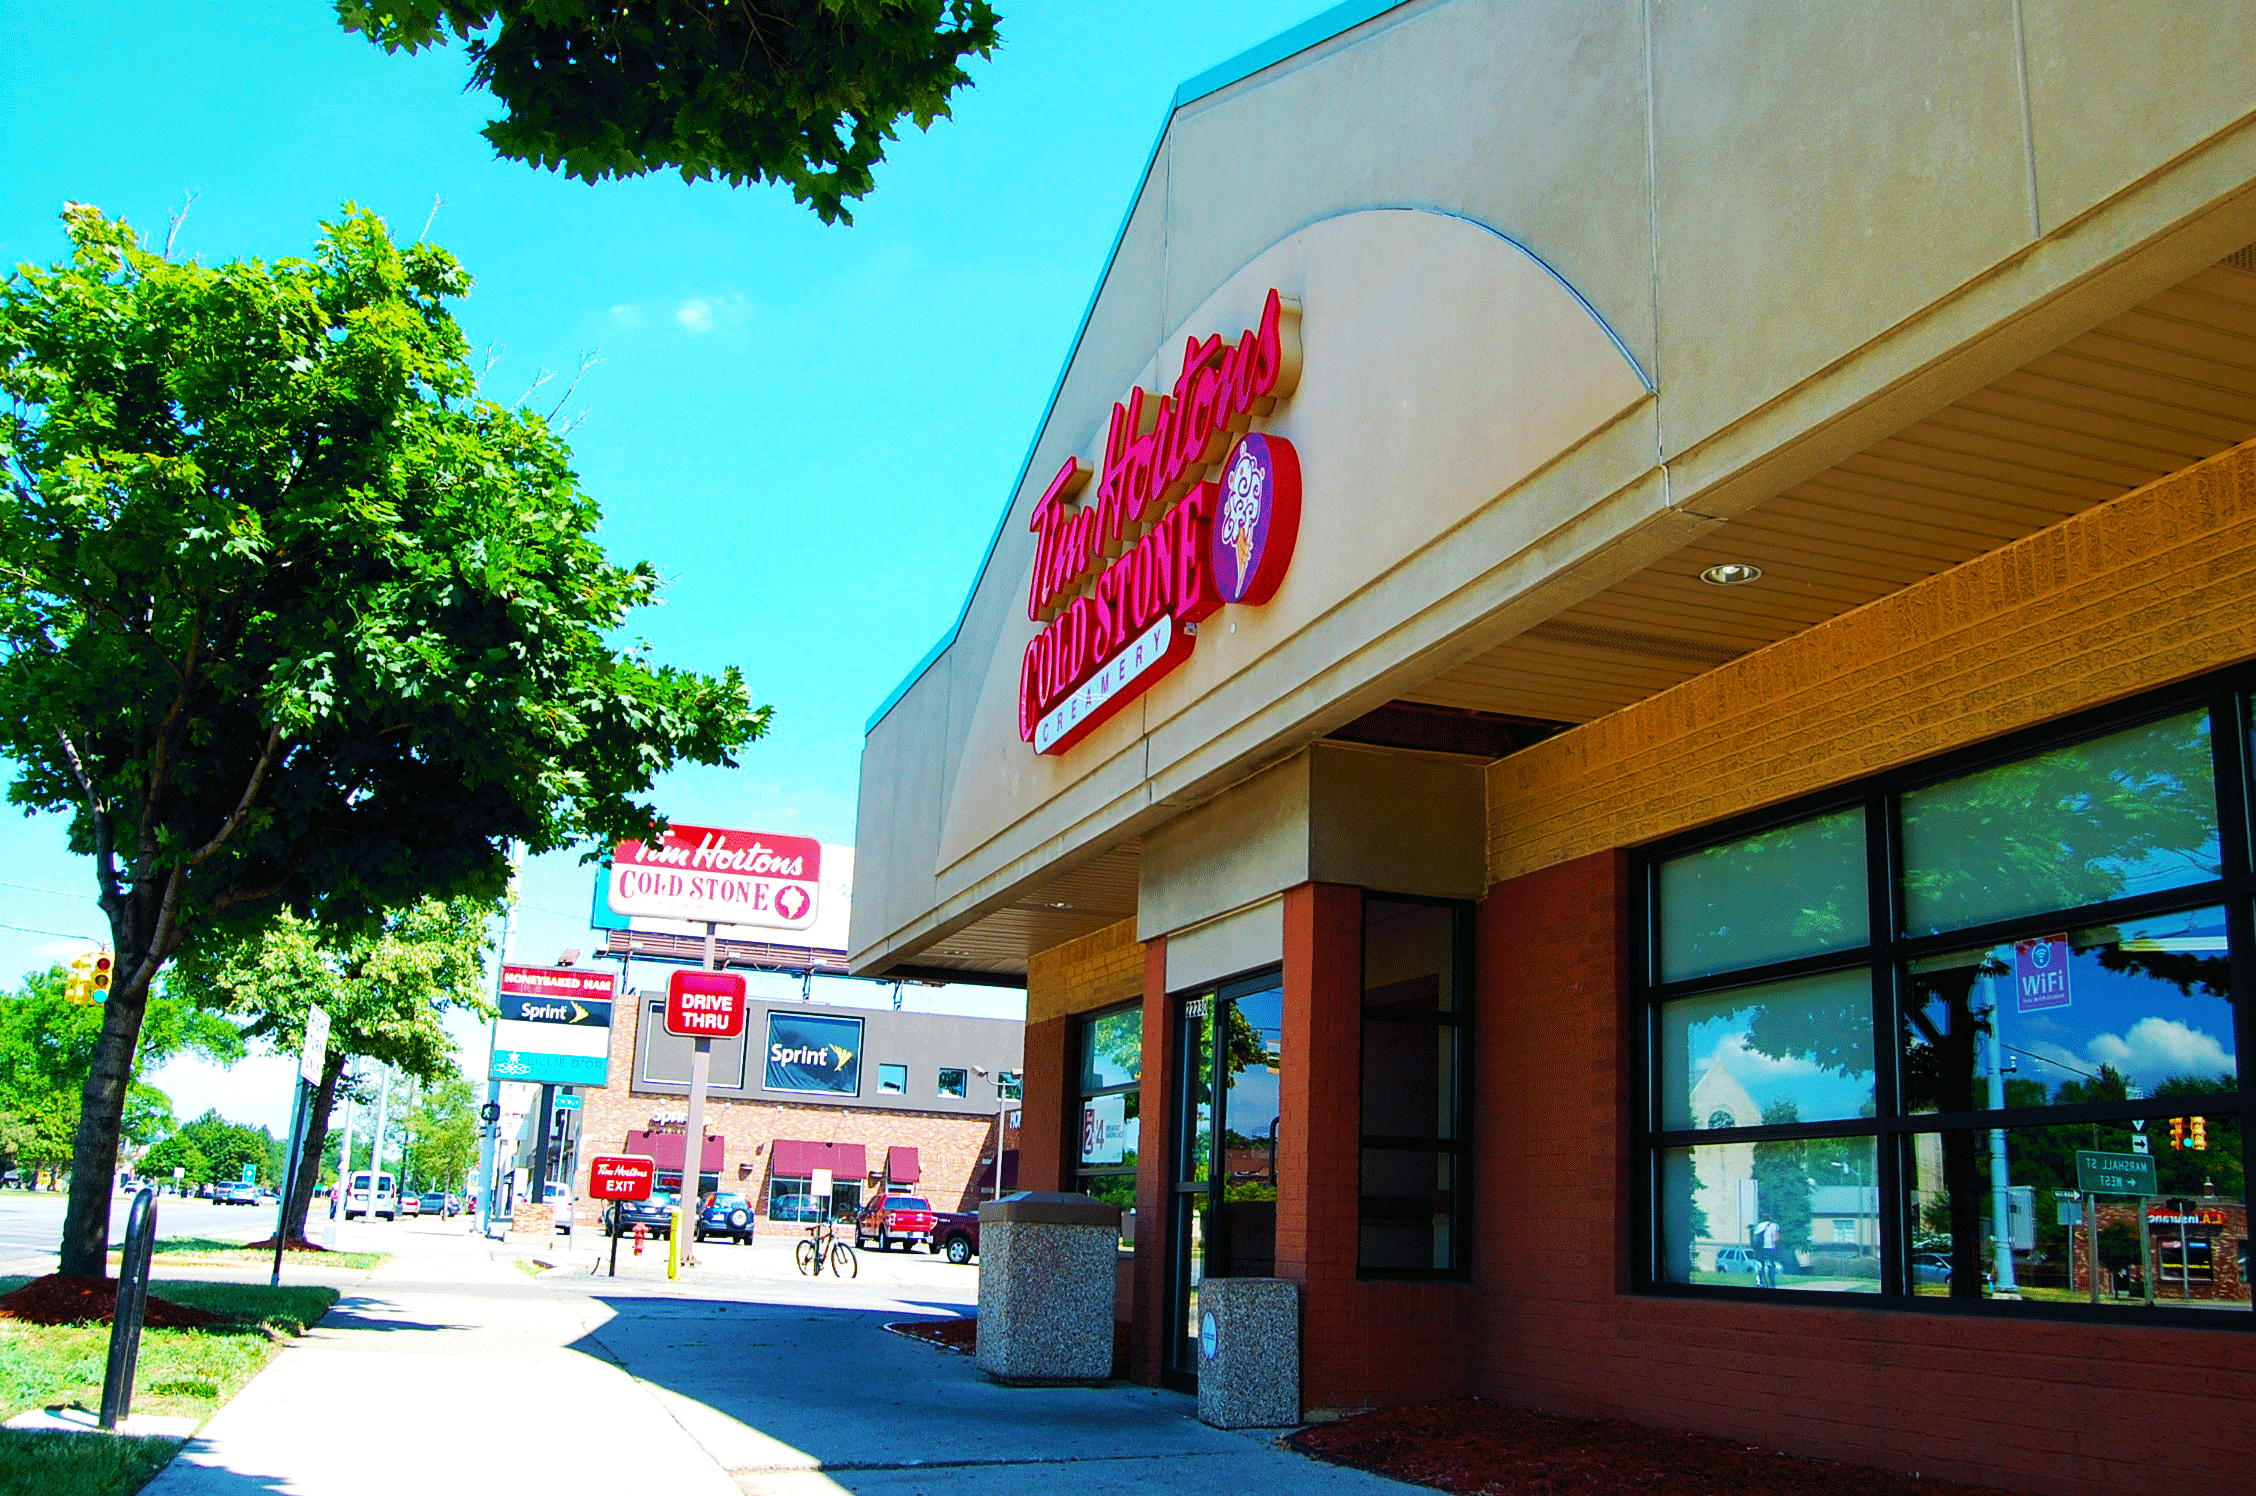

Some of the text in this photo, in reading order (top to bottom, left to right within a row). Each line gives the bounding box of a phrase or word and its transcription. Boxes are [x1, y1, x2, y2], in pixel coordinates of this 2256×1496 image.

[1028, 288, 1281, 622] Tim Hortons
[1019, 482, 1207, 743] COLD STONE
[1043, 629, 1161, 742] CREAMERY
[692, 832, 804, 876] Hortons
[619, 870, 684, 899] COLD
[690, 876, 770, 911] STONE
[504, 972, 611, 992] HONEYBAKED HAM
[2022, 969, 2065, 996] WiFi
[521, 1002, 567, 1021] Sprint
[681, 993, 733, 1012] DRIVE
[682, 1012, 730, 1030] THRU
[770, 1044, 828, 1067] Sprint
[597, 1163, 648, 1178] Tim Hortons
[606, 1180, 635, 1193] EXIT
